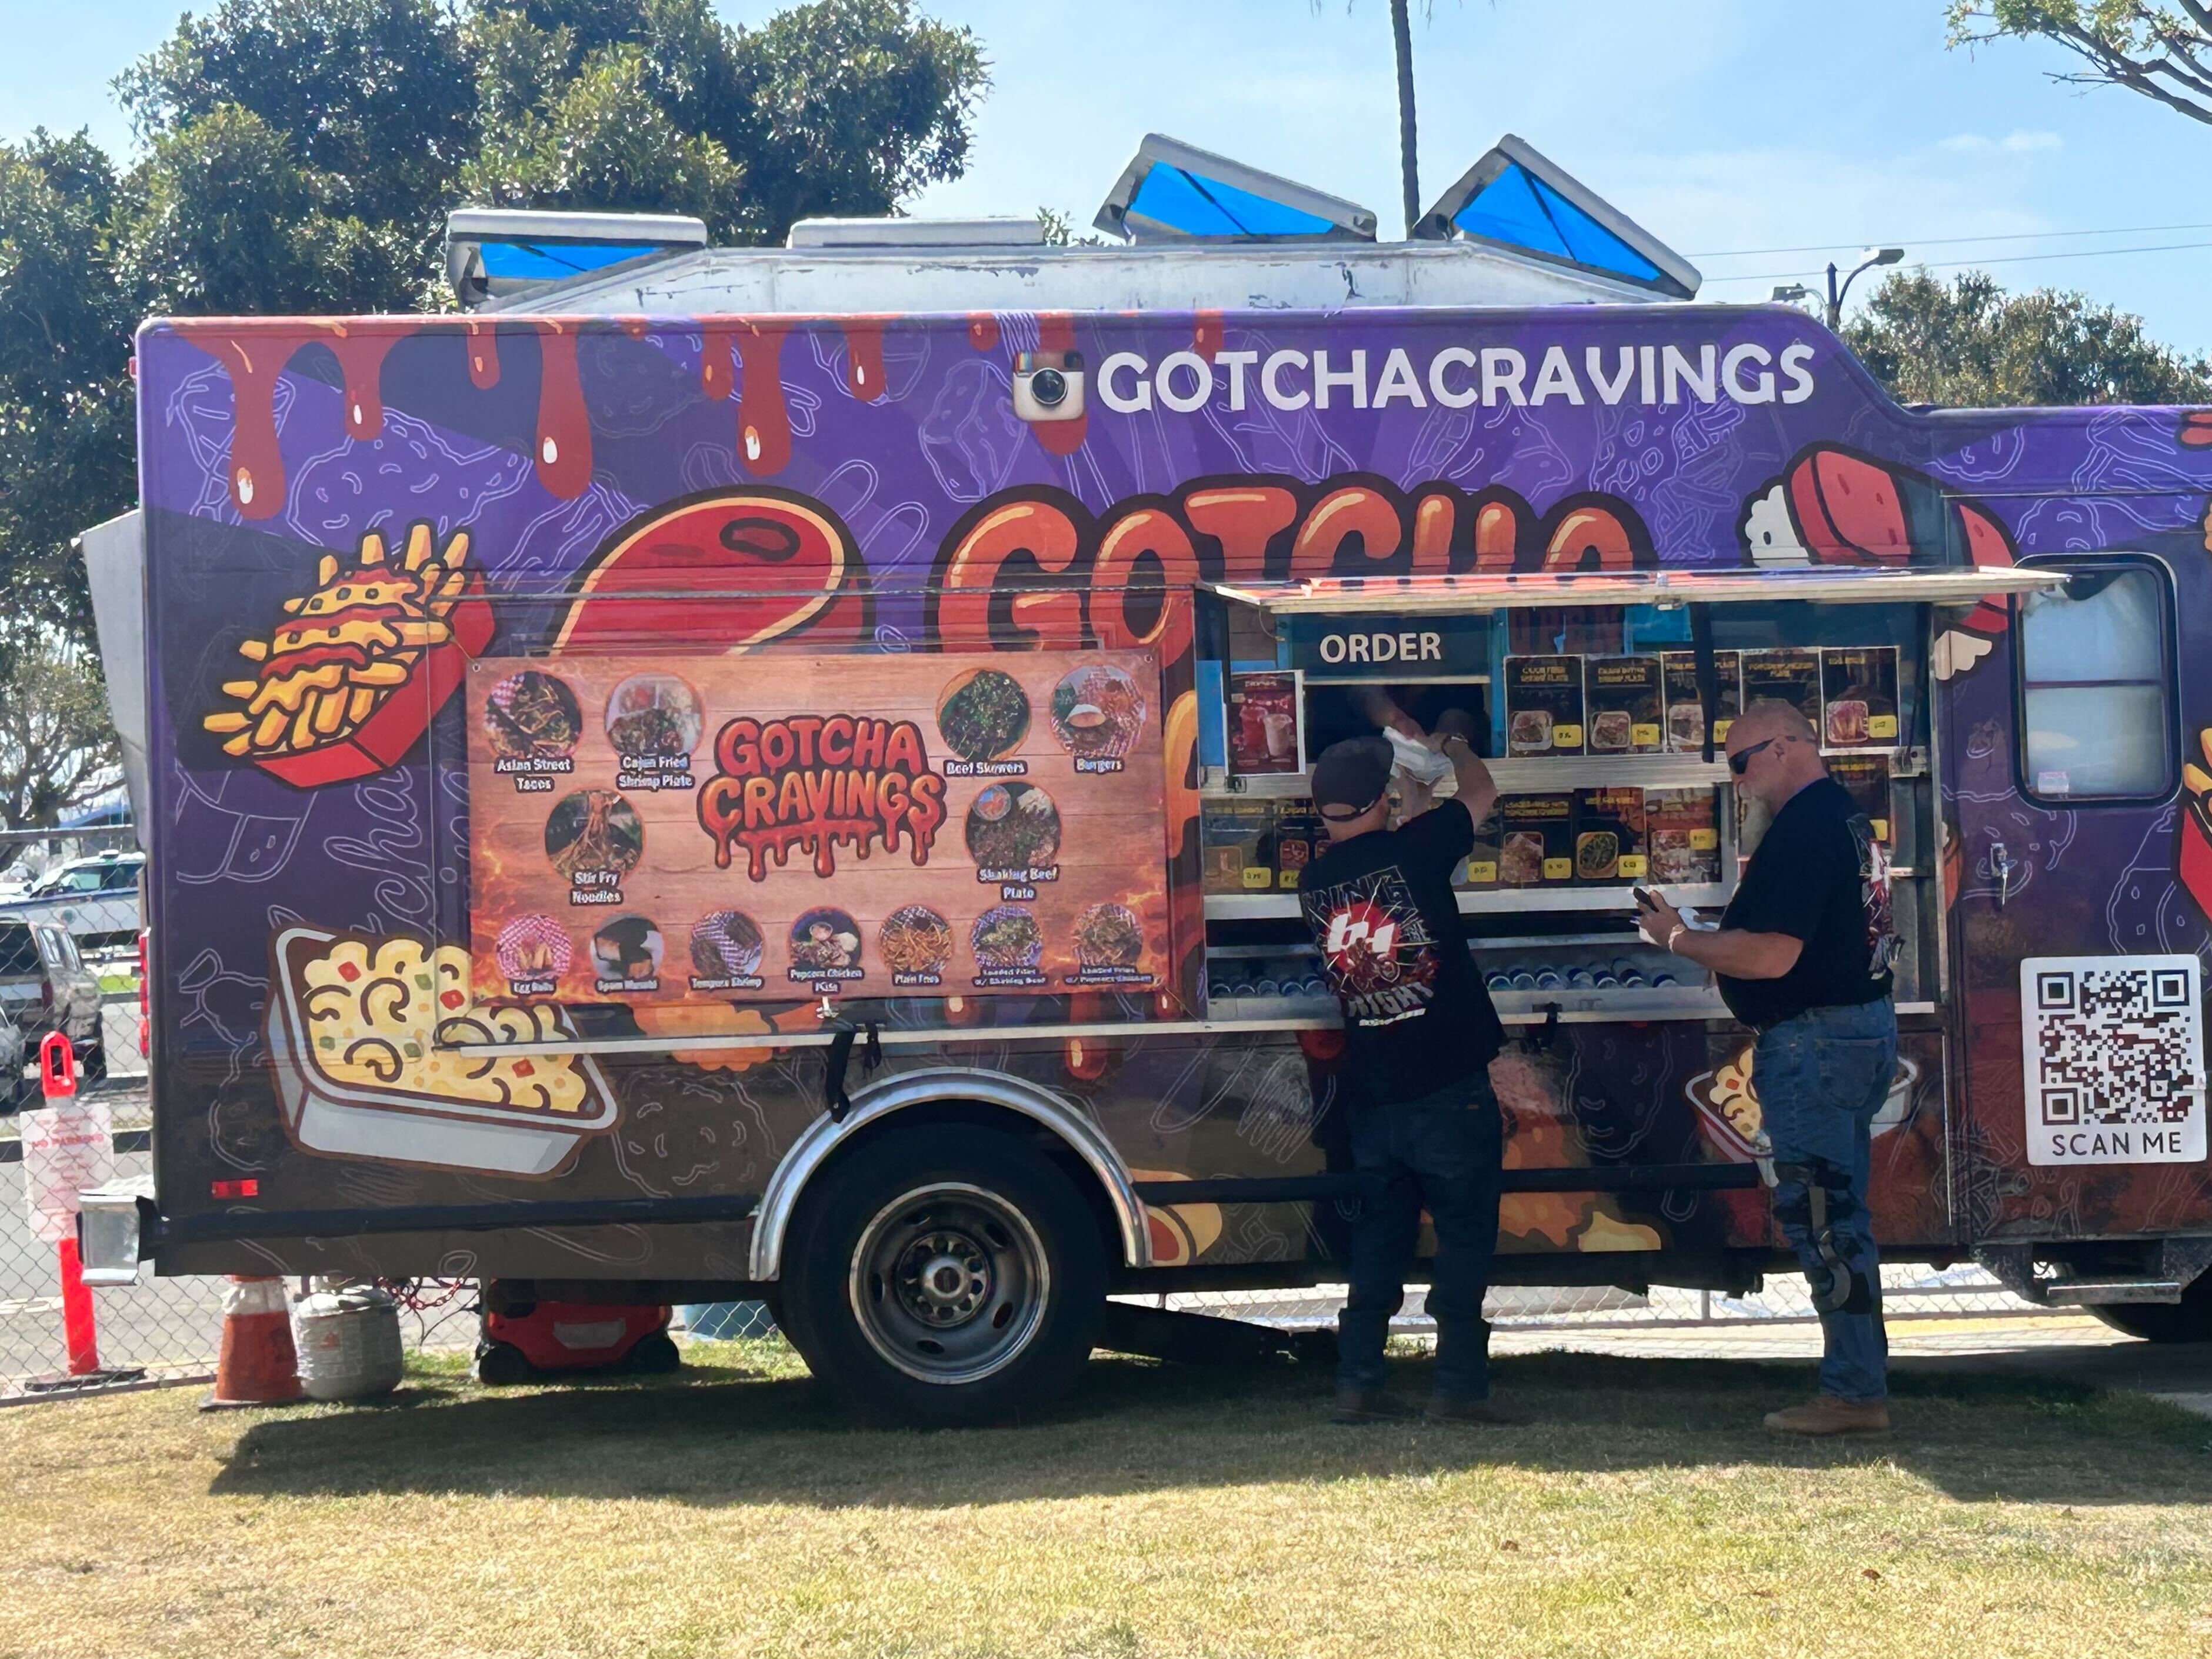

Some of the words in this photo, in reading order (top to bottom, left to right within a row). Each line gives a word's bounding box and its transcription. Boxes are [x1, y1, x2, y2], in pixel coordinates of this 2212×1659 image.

[1097, 344, 1815, 412] GOTCHACRAVINGS
[1320, 632, 1441, 663] ORDER
[717, 717, 924, 777] GOTCHA
[497, 759, 531, 771] Asian
[533, 759, 571, 771] Street
[622, 756, 657, 771] Cajun
[658, 756, 688, 768] Fried
[946, 762, 973, 774] Beef
[1076, 758, 1122, 773] Burgers
[515, 777, 552, 791] Tacos
[618, 774, 661, 789] Shrimp
[662, 774, 693, 787] Plate
[702, 768, 941, 841] CRAVINGS
[574, 871, 598, 884] Stir
[599, 871, 618, 886] Fry
[979, 868, 1028, 882] Shaking
[1030, 867, 1058, 880] Beef
[572, 890, 622, 904] Noodles
[1003, 886, 1035, 900] Plate
[2051, 1132, 2130, 1157] SCAN
[2143, 1131, 2182, 1154] ME
